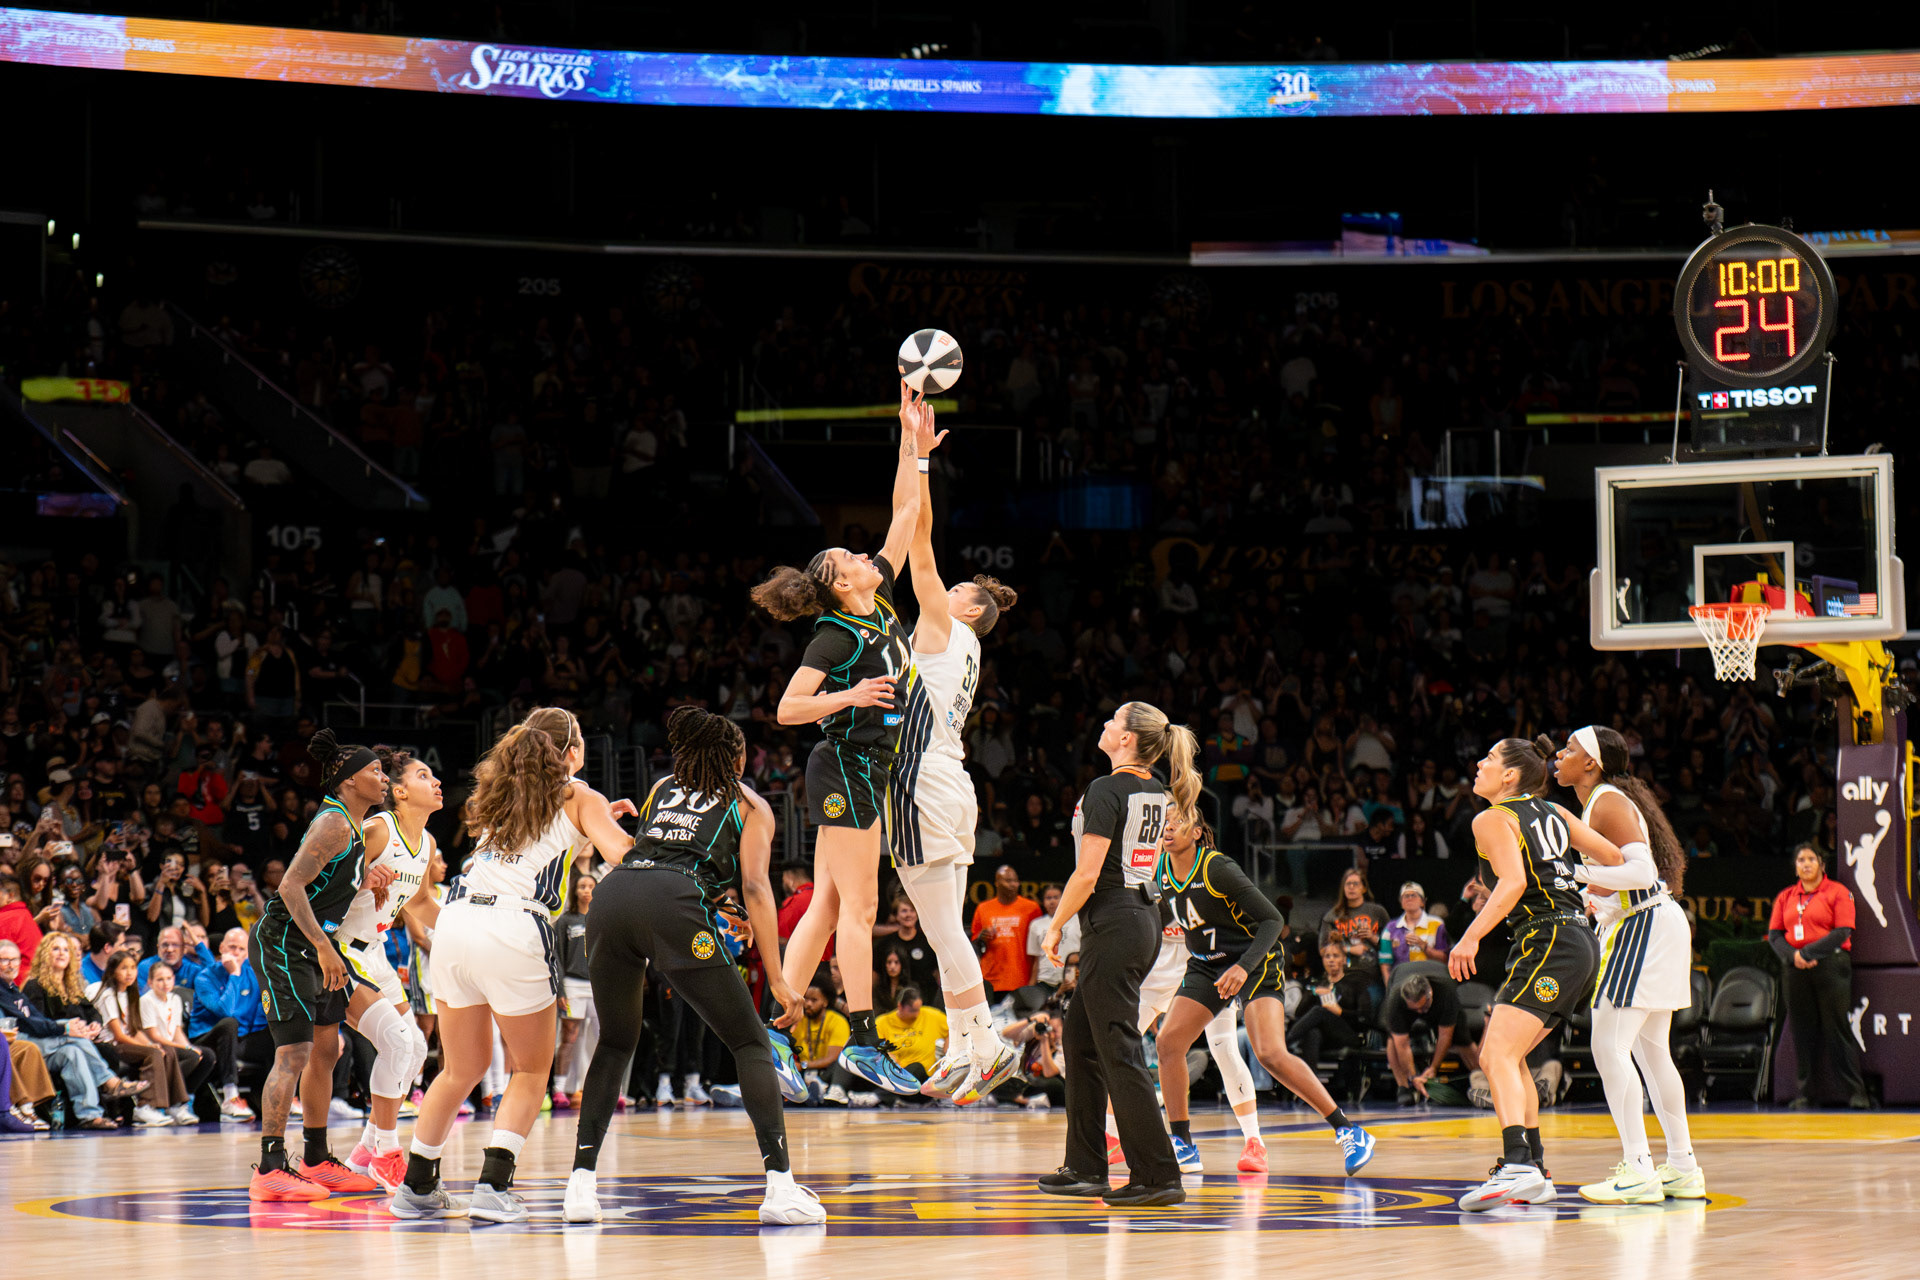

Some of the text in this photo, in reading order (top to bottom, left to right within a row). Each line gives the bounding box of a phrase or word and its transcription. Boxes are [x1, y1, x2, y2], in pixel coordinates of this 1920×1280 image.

[459, 44, 590, 98] SPARKS
[499, 50, 593, 67] LOS ANGELES
[1276, 71, 1310, 97] 30
[517, 276, 562, 297] 205
[1719, 258, 1800, 297] 10:00
[1440, 279, 1533, 320] LOS
[1714, 295, 1796, 362] 24
[1730, 385, 1817, 408] TISSOT
[265, 524, 323, 552] 105
[960, 544, 1016, 571] 106
[1842, 776, 1889, 806] ally
[247, 811, 260, 832] 5
[664, 828, 695, 841] AT&T
[1138, 803, 1161, 844] 28
[1530, 813, 1569, 860] 10
[1169, 895, 1206, 931] LA
[1202, 927, 1217, 951] 7
